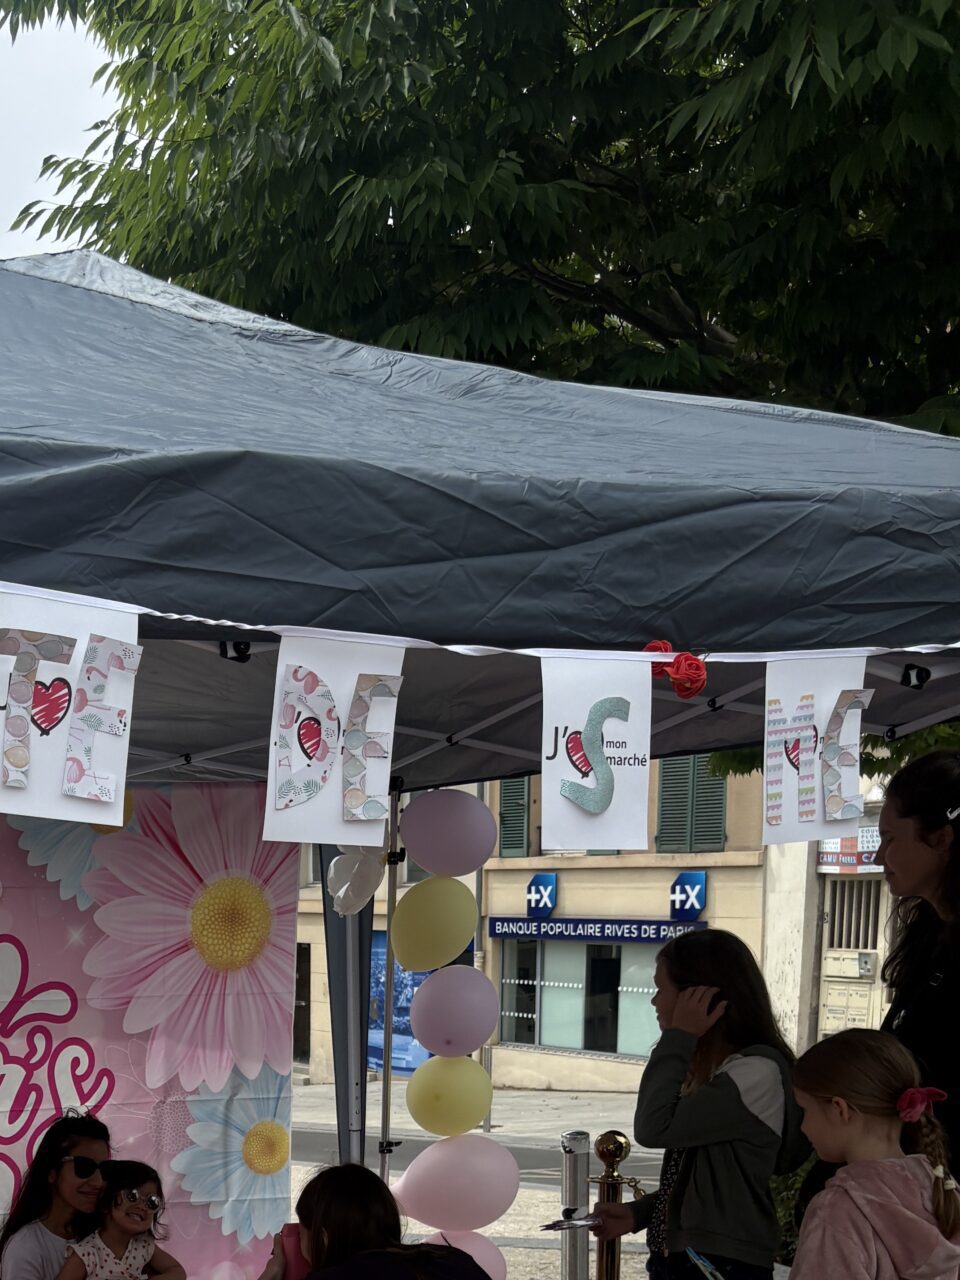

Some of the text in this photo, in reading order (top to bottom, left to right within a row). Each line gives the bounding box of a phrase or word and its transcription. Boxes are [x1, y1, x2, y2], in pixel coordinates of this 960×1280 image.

[605, 740, 627, 750] mon
[605, 753, 647, 767] marché
[495, 922, 538, 935] BANQUE
[541, 922, 602, 937] POPULAIRE
[604, 924, 638, 938] RIVES
[640, 925, 657, 938] DE
